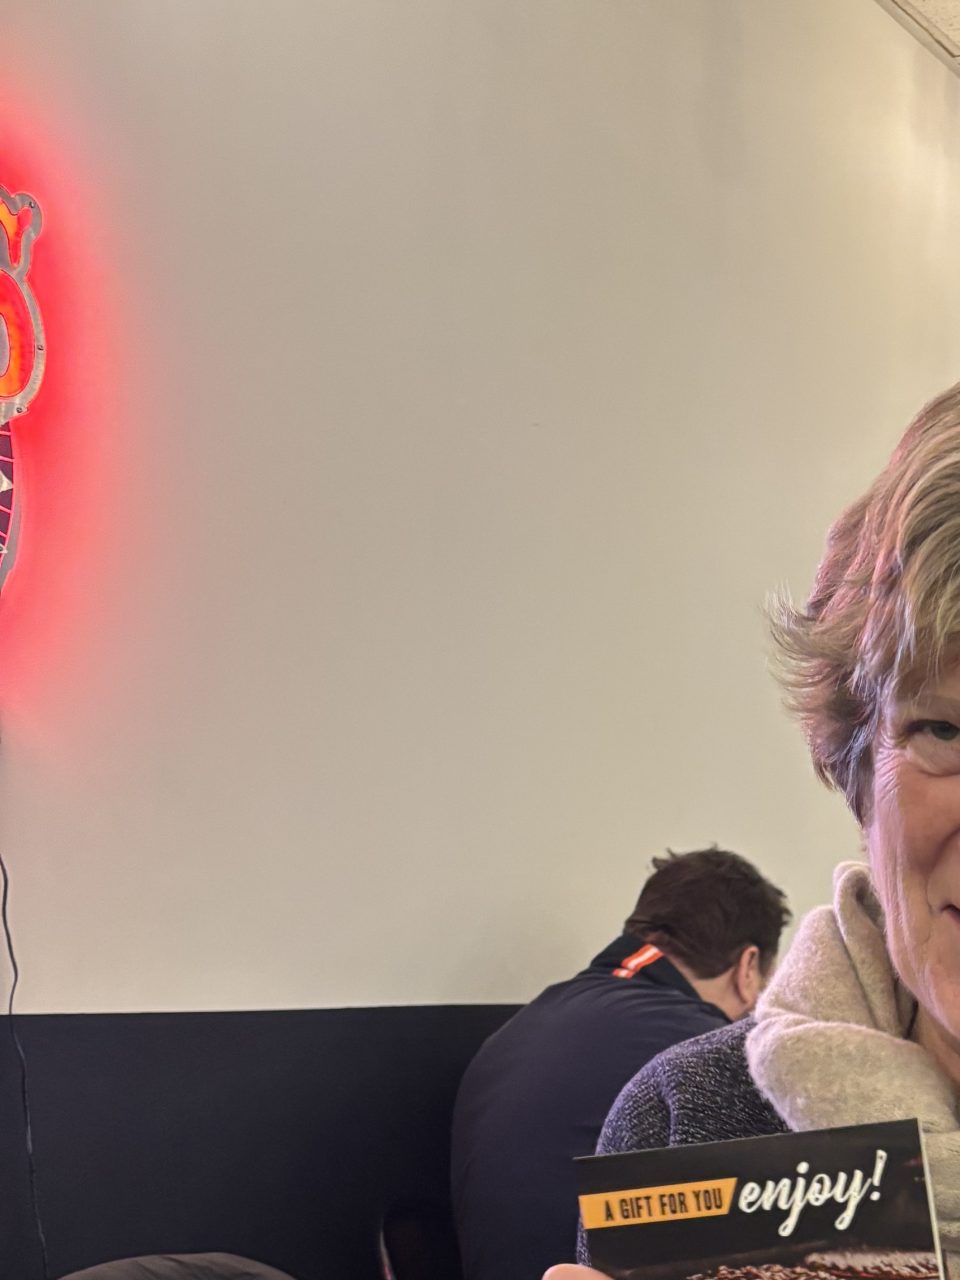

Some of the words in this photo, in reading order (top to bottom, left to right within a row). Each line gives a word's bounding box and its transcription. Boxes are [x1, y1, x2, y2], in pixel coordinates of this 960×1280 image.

[604, 1202, 614, 1222] A
[619, 1195, 653, 1220] GIFT
[659, 1191, 688, 1215] FOR
[692, 1187, 724, 1212] YOU
[738, 1149, 888, 1237] enjoy!
